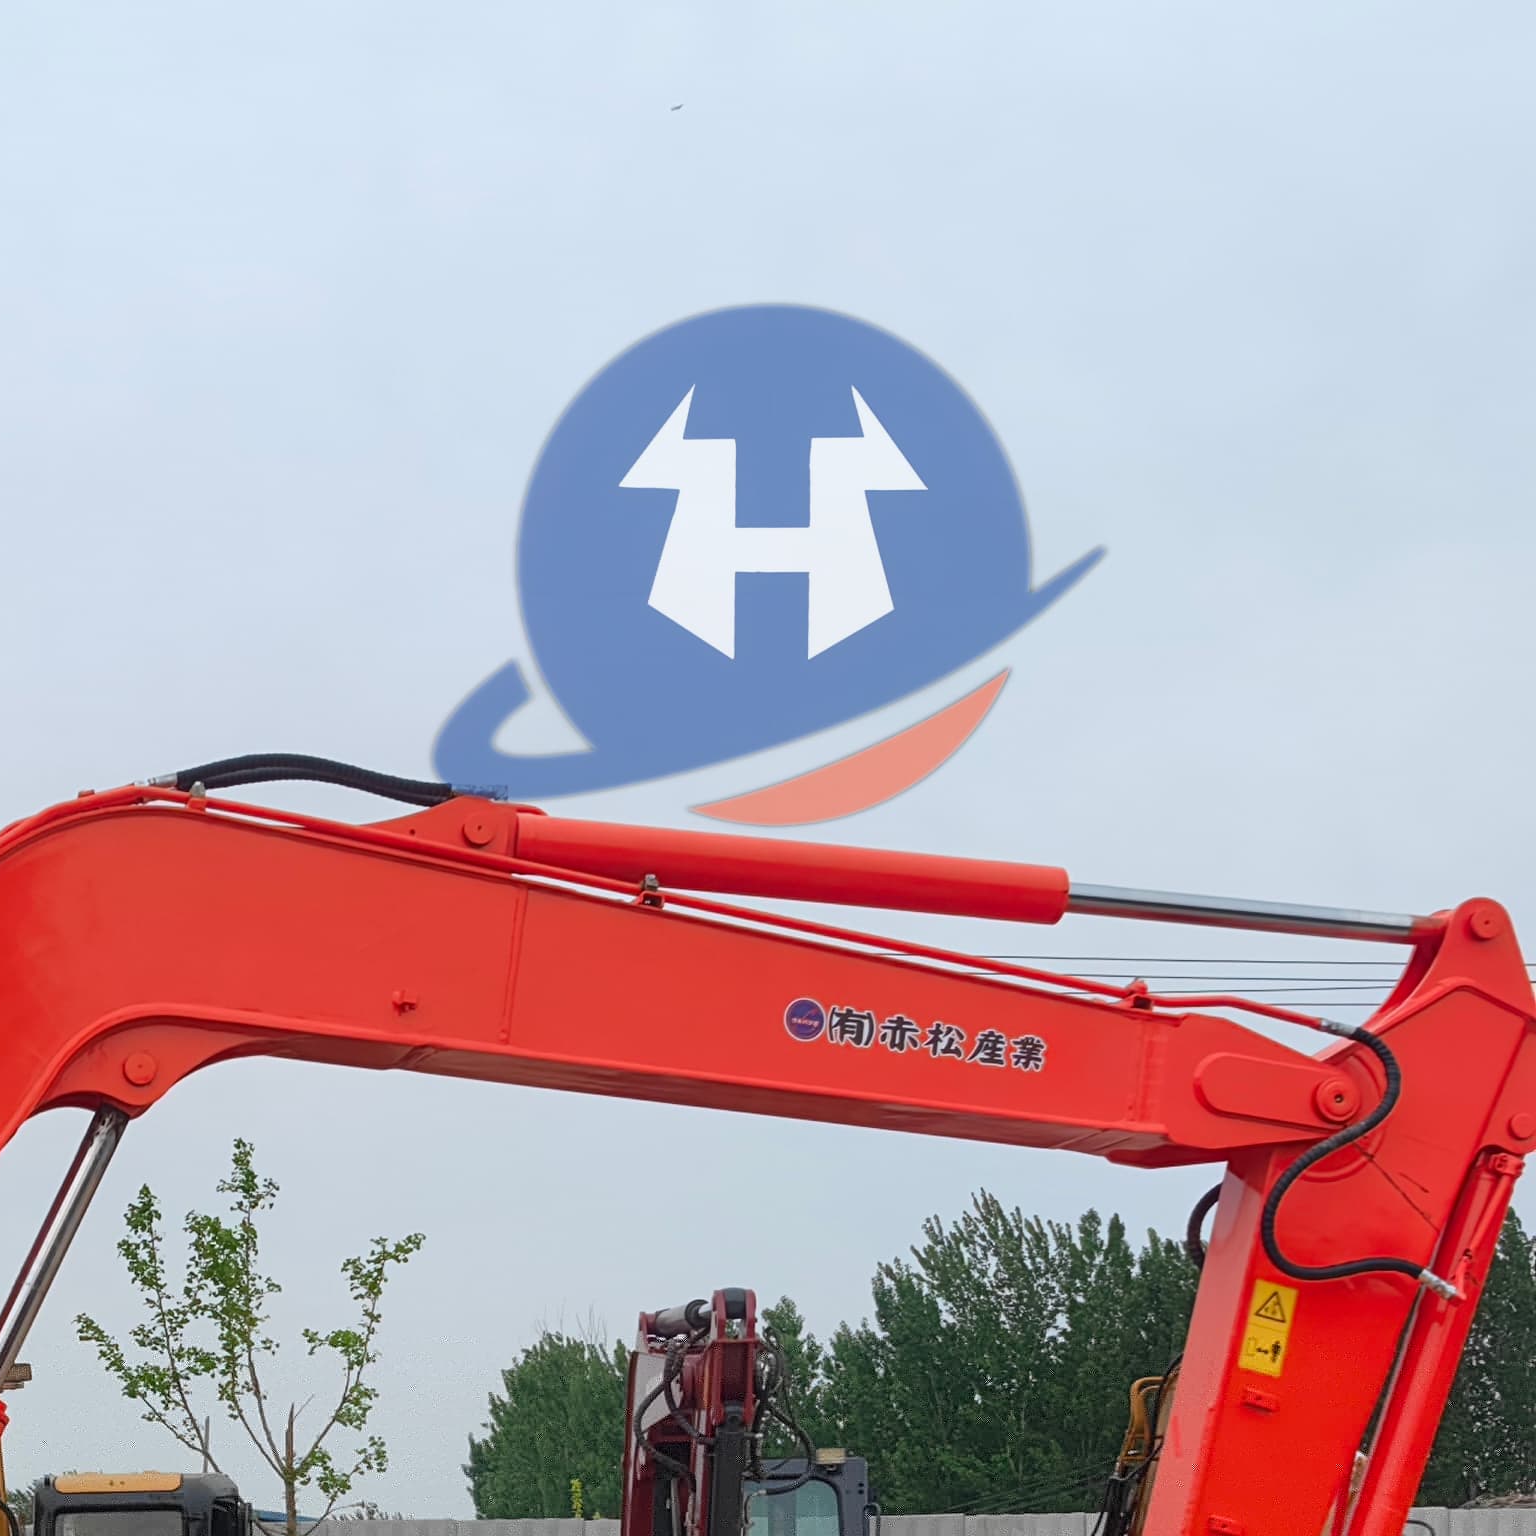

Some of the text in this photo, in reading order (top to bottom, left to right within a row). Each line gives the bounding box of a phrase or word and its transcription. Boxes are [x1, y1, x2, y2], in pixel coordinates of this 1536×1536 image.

[828, 1006, 1046, 1070] (有)赤松産業
